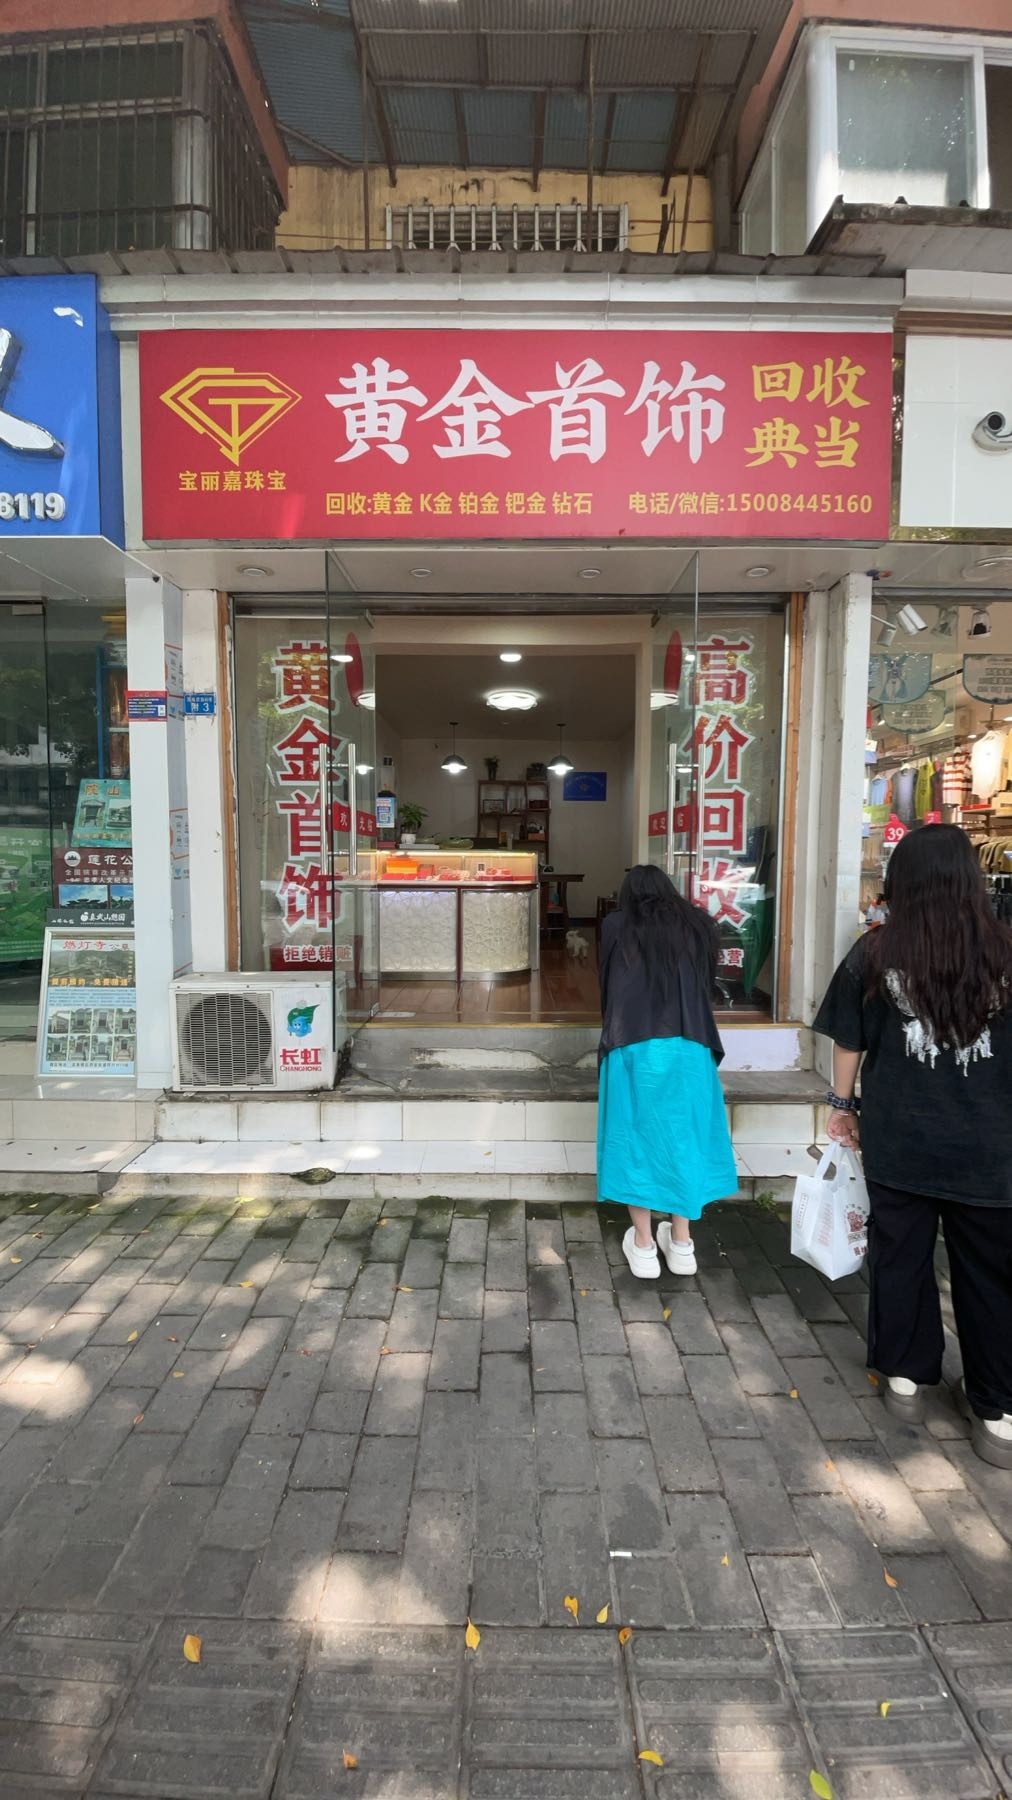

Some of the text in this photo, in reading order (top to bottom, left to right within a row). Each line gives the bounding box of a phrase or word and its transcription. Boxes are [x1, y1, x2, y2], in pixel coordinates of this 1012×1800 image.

[752, 355, 871, 408] 回收
[325, 357, 727, 464] 黄金首饰
[744, 416, 861, 469] 典当
[178, 469, 287, 492] 宝丽嘉珠宝
[420, 490, 453, 515] K金
[458, 490, 500, 515] 铂金
[505, 490, 547, 515] 钯金
[552, 490, 593, 515] 钻石
[274, 640, 348, 933] 黄金首饰
[682, 635, 755, 929] 高价回收
[887, 827, 905, 841] 39
[280, 1048, 322, 1065] 长虹
